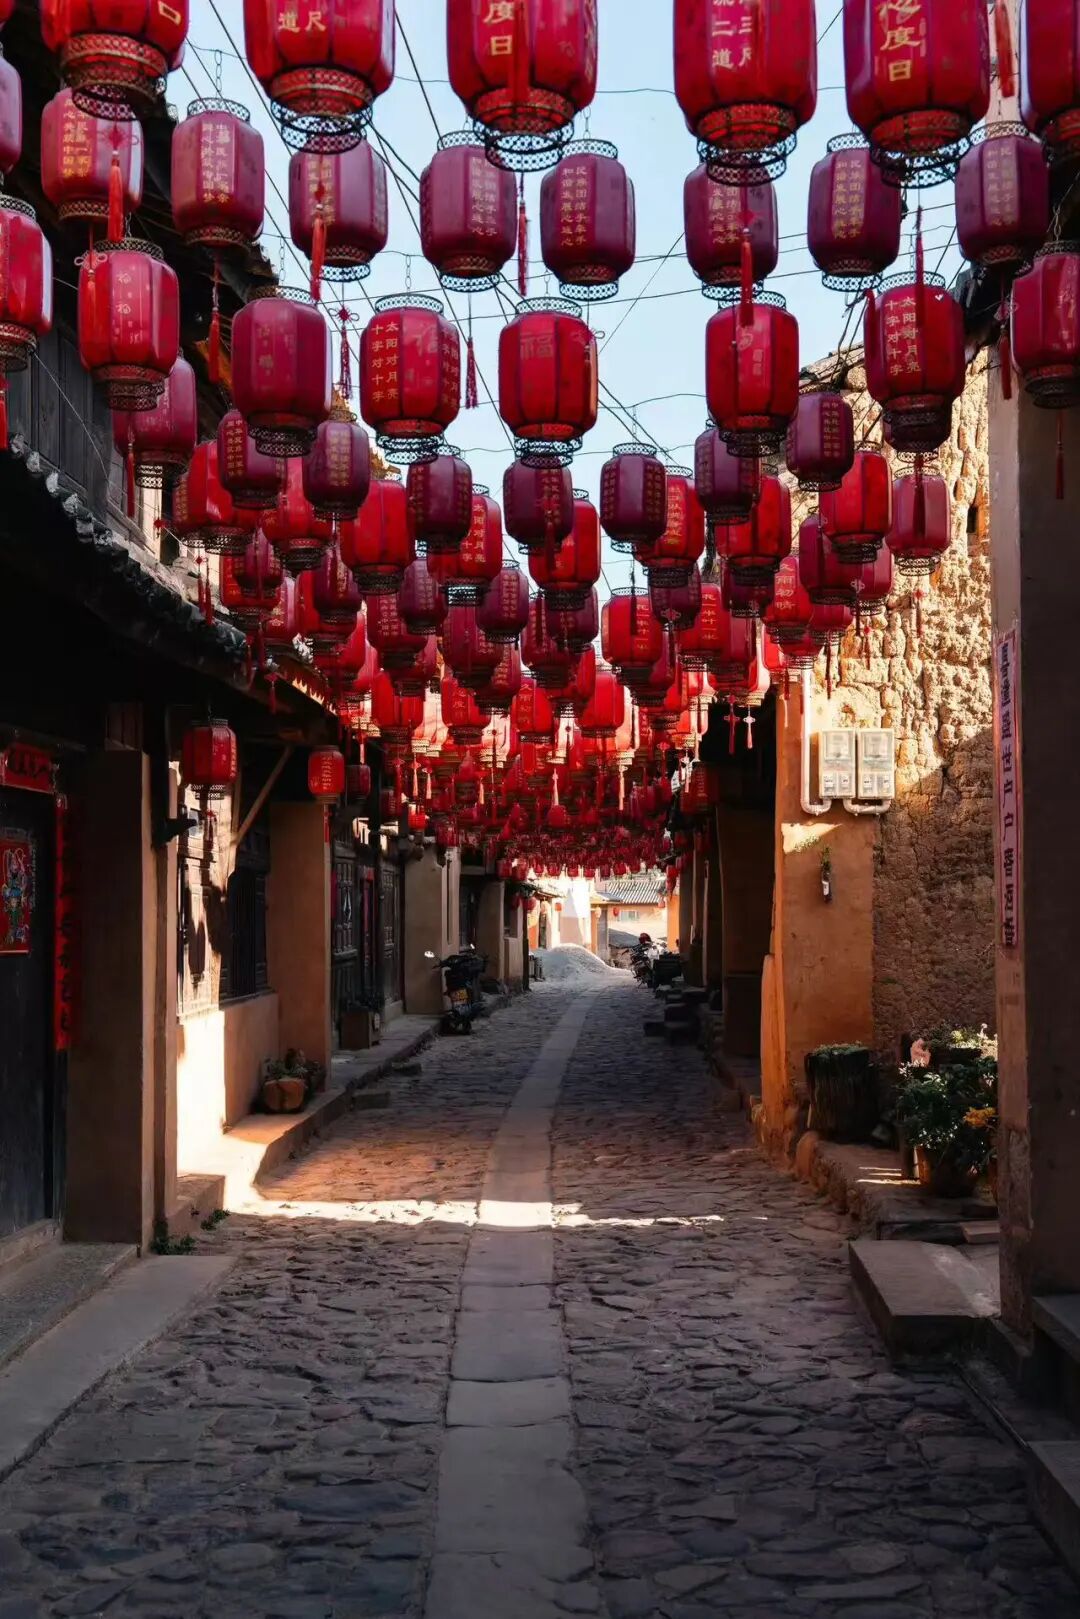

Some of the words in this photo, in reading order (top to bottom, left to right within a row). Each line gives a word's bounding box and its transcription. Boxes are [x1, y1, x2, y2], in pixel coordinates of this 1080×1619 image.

[279, 10, 299, 33] 道
[305, 11, 326, 31] 尺
[713, 181, 725, 244] 发展心连心
[372, 324, 385, 404] 十字对十字
[385, 320, 399, 402] 太阳对月亮
[886, 299, 902, 376] 十字对十字
[901, 296, 920, 374] 太阳对月亮
